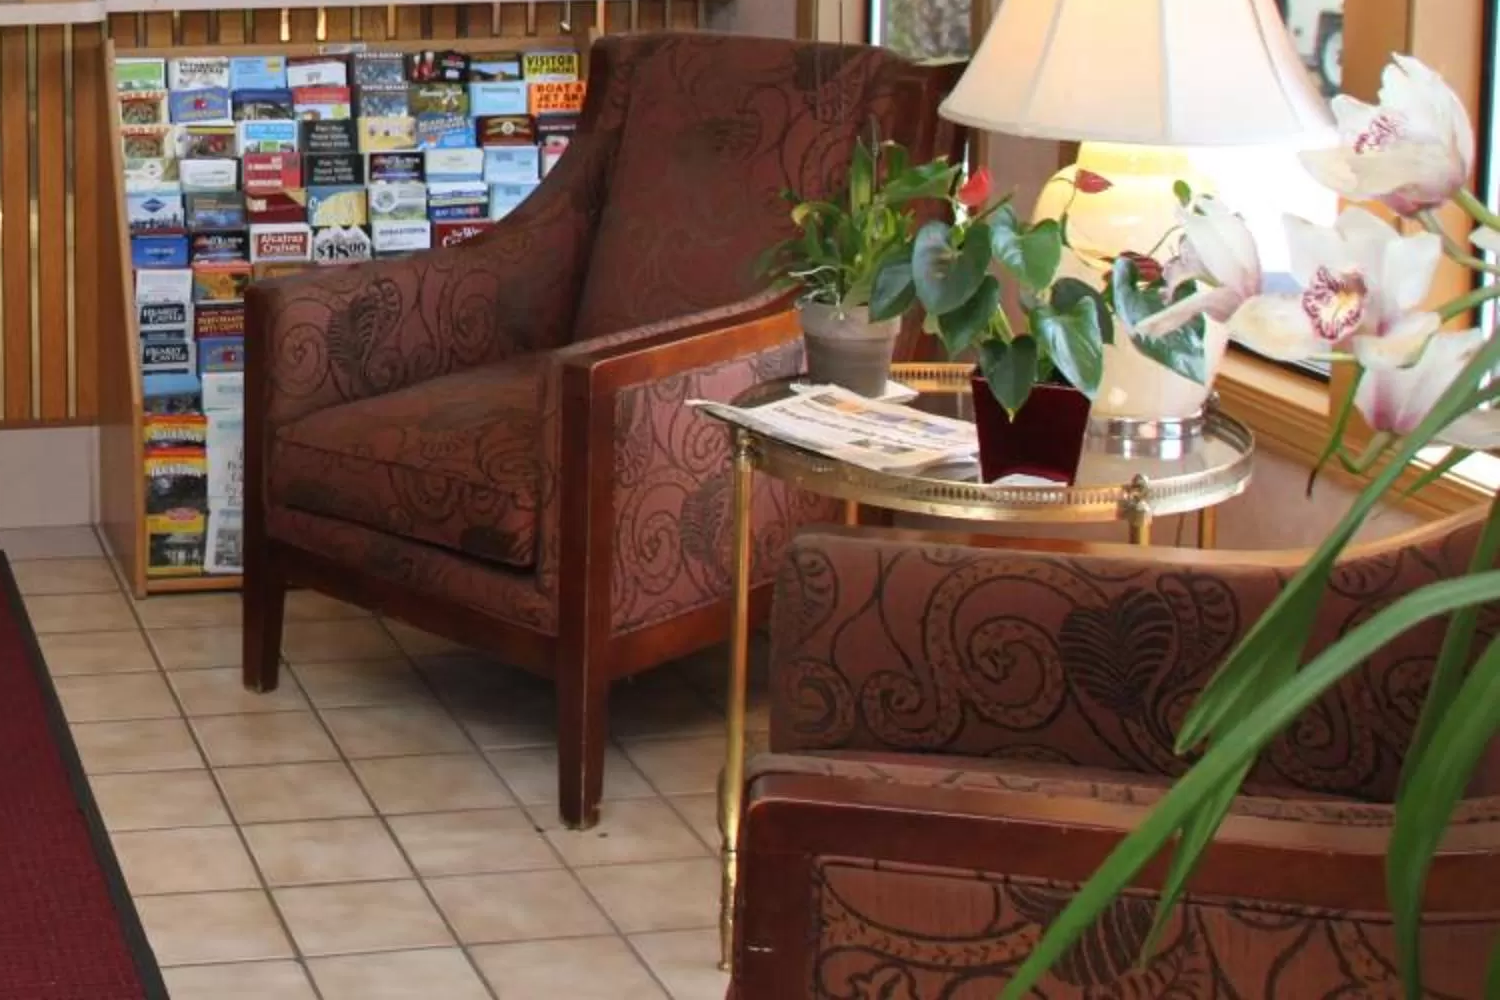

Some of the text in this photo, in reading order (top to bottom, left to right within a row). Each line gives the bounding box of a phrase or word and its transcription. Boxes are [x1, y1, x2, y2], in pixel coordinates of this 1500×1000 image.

[526, 54, 575, 66] VISITOR
[536, 83, 571, 93] BOAT
[260, 234, 304, 244] Alcatraz
[262, 243, 301, 254] Cruises
